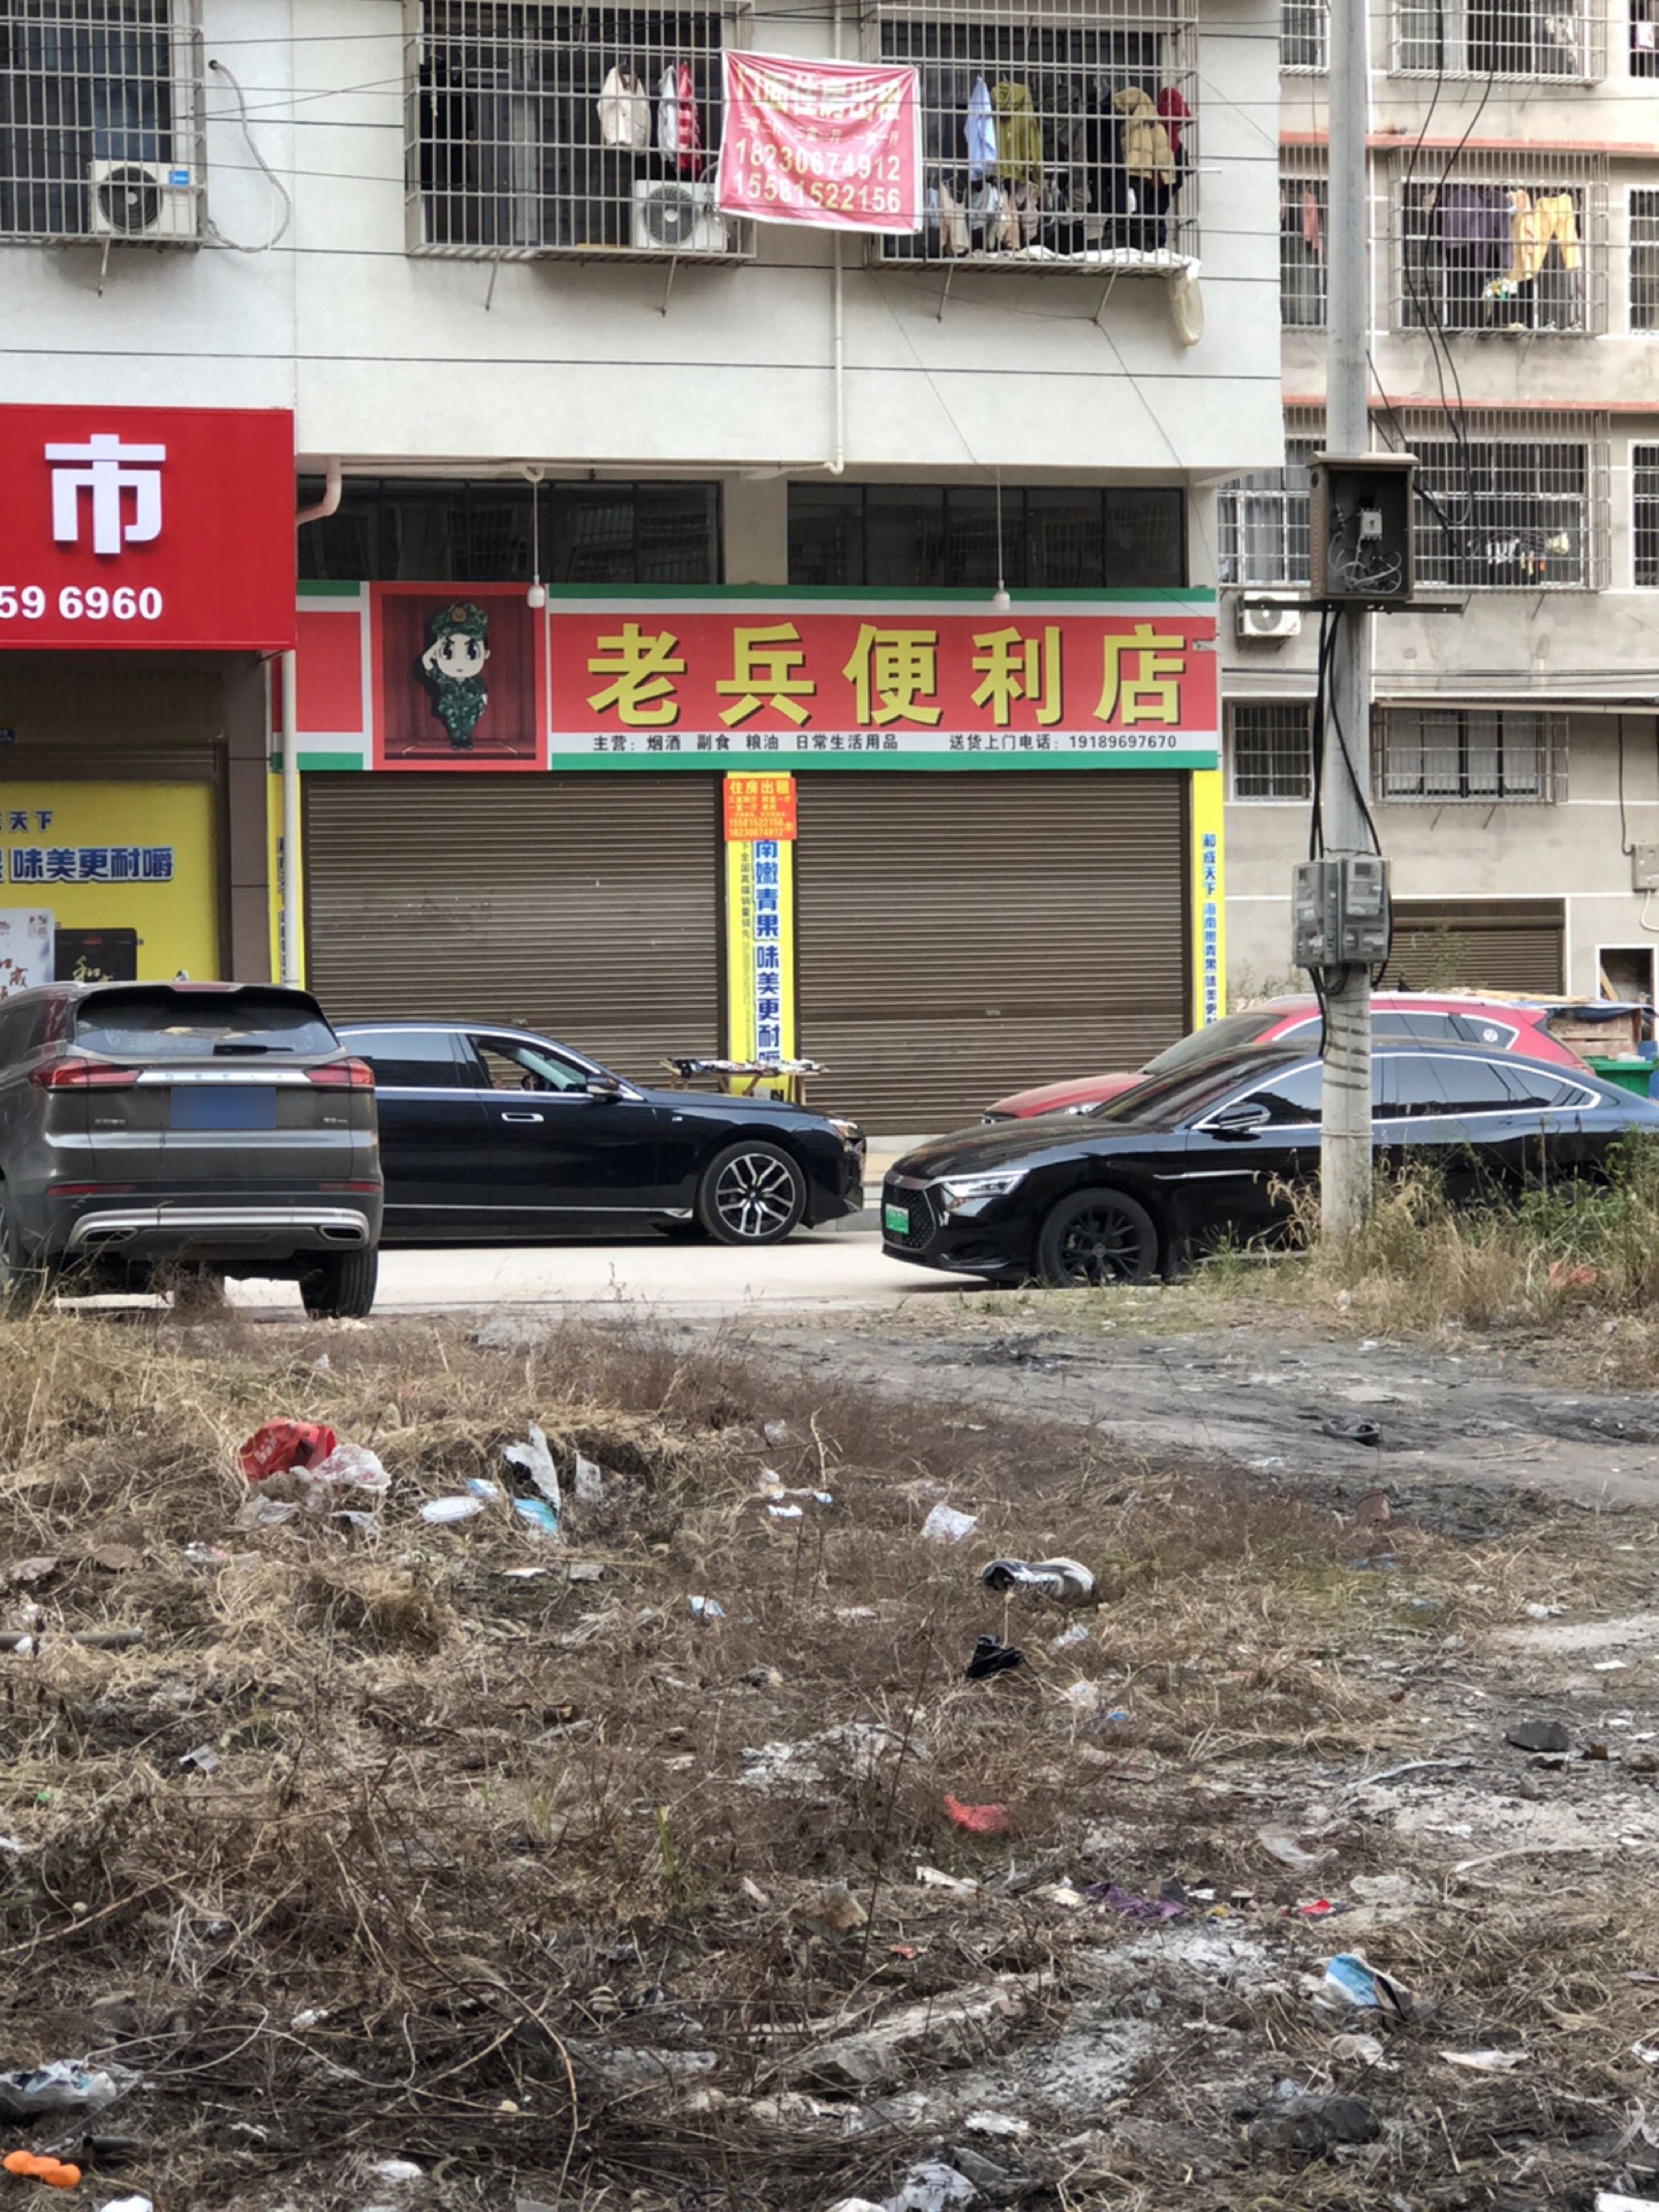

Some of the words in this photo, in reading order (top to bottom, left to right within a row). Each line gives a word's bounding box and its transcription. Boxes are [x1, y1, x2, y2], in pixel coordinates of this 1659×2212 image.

[735, 138, 900, 182] 18230674912
[45, 433, 166, 554] 市
[58, 586, 163, 620] 6960
[586, 622, 1187, 726] 老兵便利店
[646, 734, 681, 751] 烟酒
[696, 733, 730, 751] 副食
[746, 733, 780, 751] 粮油
[796, 733, 898, 751] 日常生活用品
[1069, 735, 1178, 749] 19189697670
[0, 810, 53, 830] 天下
[13, 847, 173, 878] 味美更耐嚼
